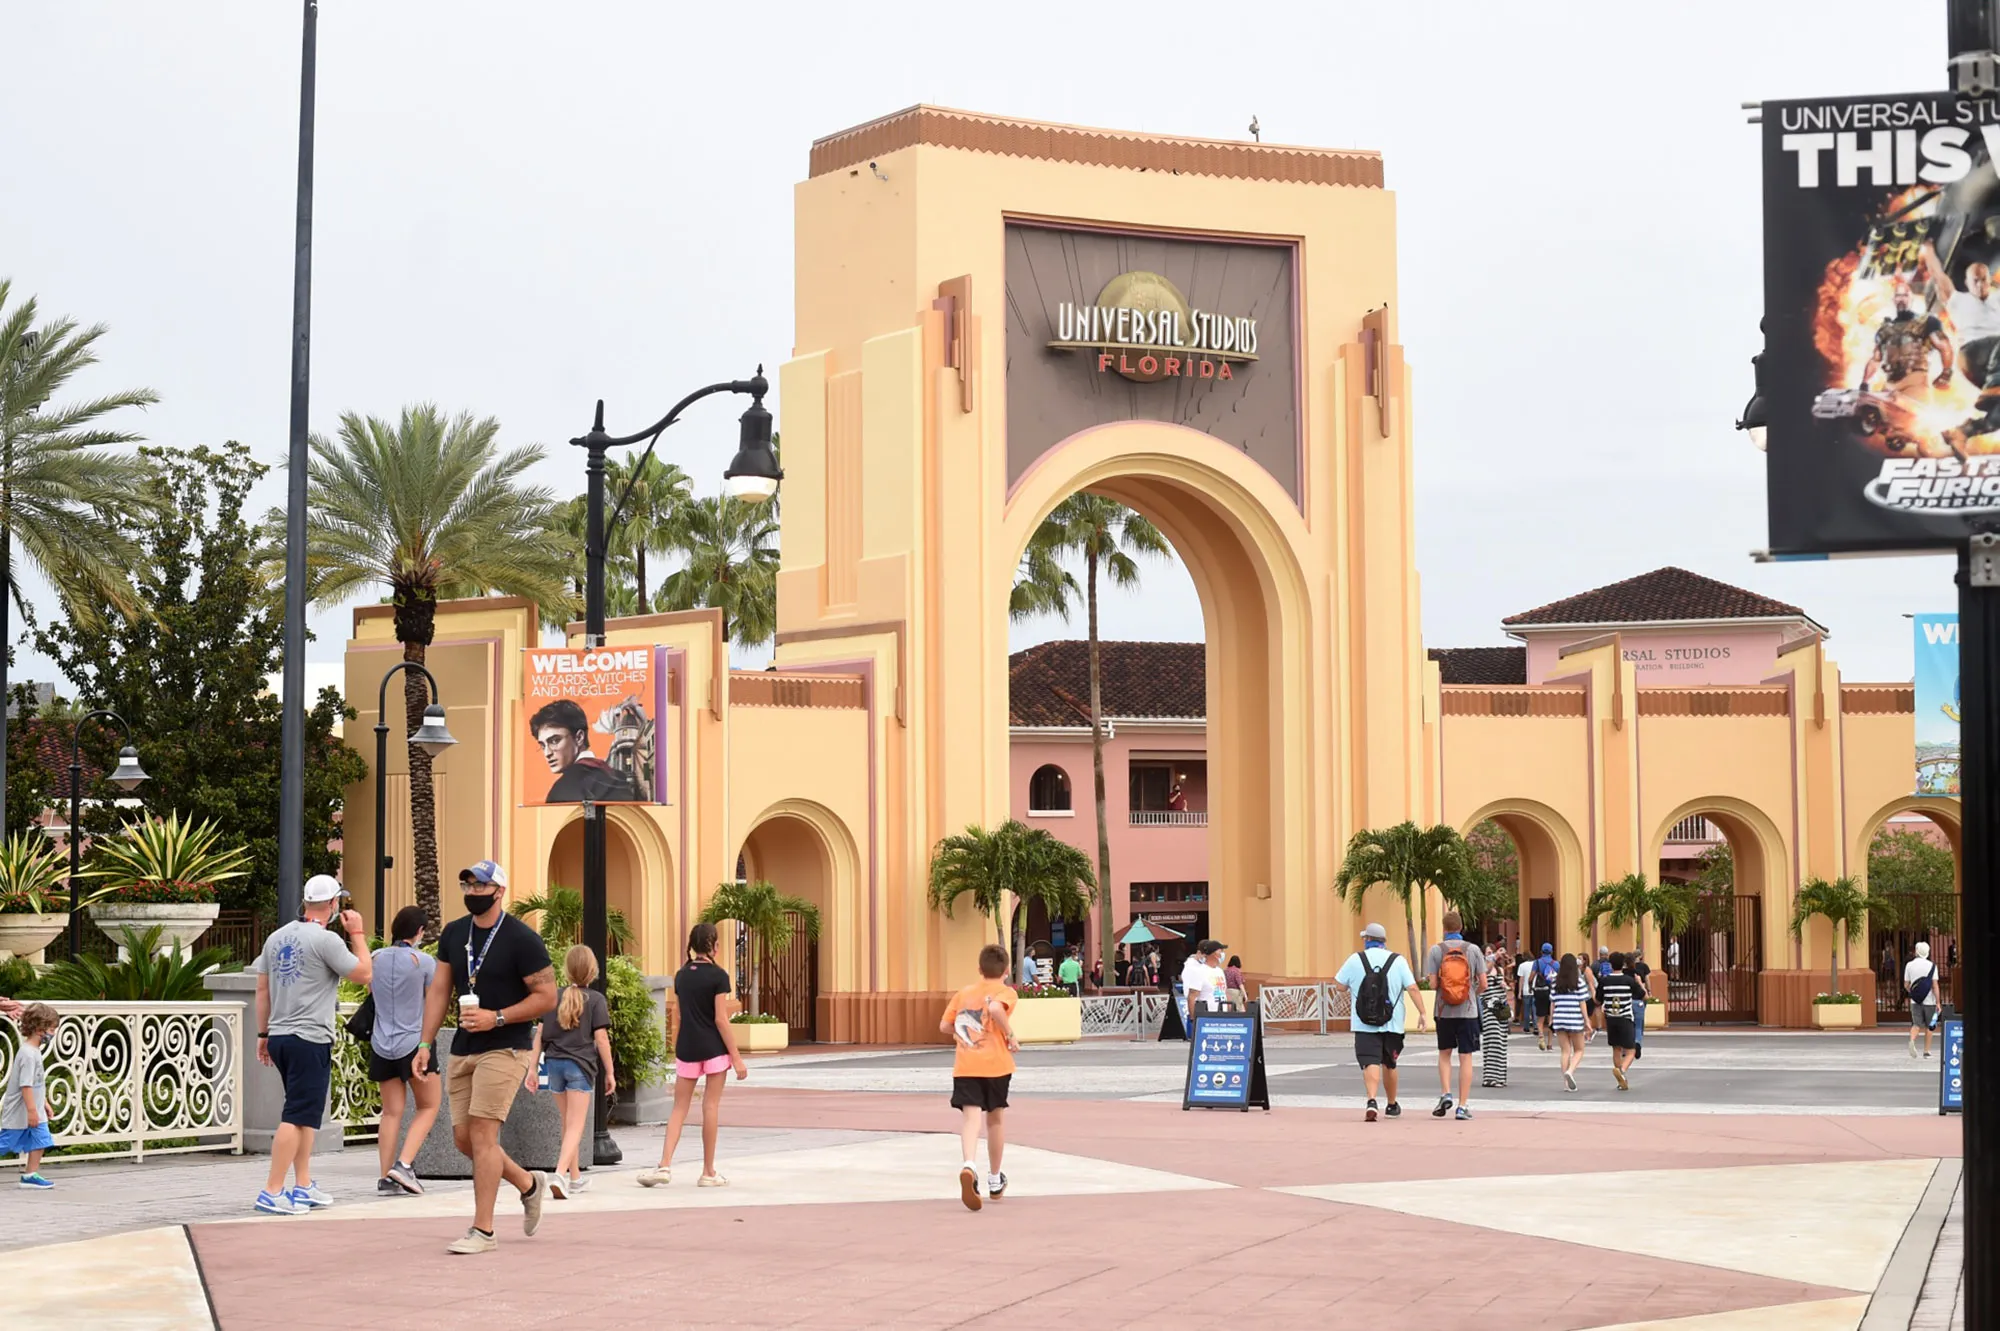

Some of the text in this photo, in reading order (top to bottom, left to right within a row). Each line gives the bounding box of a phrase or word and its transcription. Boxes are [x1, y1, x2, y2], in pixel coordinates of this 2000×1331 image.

[1781, 101, 1949, 130] UNIVERSAL
[1782, 126, 1973, 188] THIS
[1058, 303, 1258, 354] UNIVERSAL STUDIOS
[1098, 355, 1233, 380] FLORIDA
[1879, 455, 1988, 484] FAST
[532, 650, 648, 674] WELCOME
[1665, 647, 1731, 660] STUDIOS
[531, 684, 622, 697] AND MUGGLES.
[532, 671, 647, 686] WIZARDS, WITCHES
